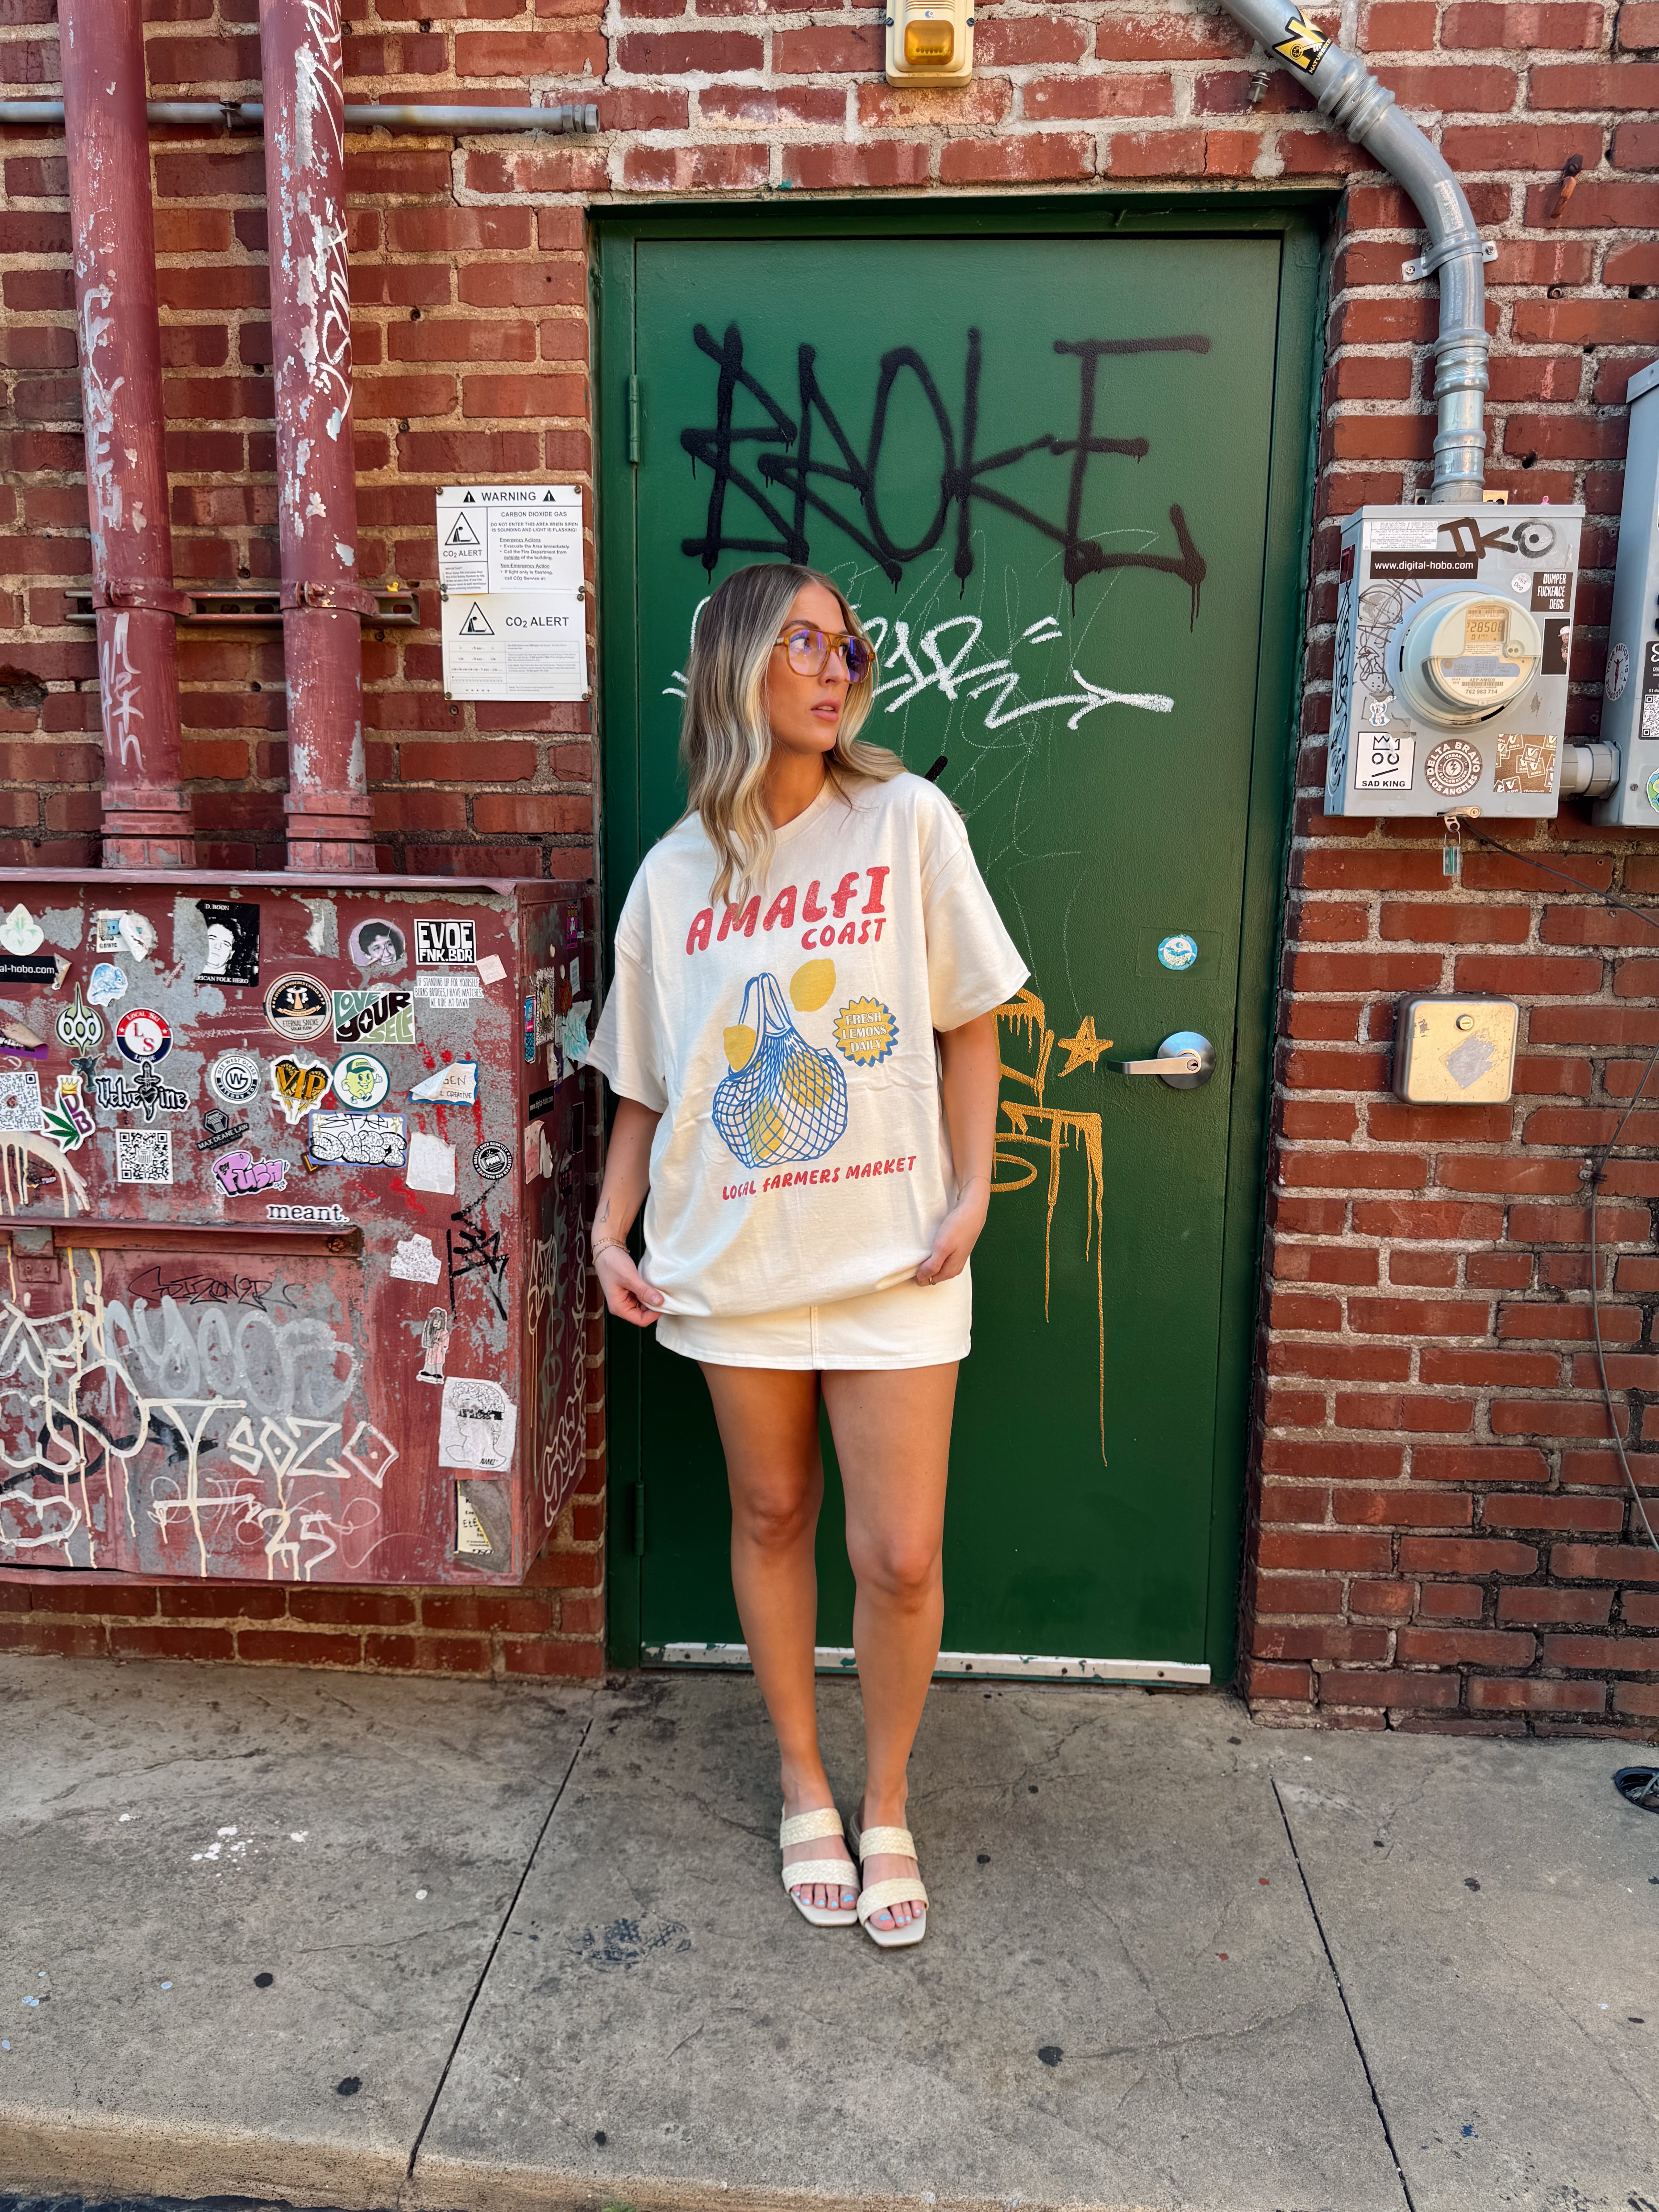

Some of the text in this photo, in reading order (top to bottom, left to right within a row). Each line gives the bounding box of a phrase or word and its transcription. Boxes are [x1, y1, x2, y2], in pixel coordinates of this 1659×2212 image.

[481, 492, 536, 501] WARNING
[1375, 561, 1473, 571] www.digital-hobo.com
[1543, 573, 1566, 584] DUMPER
[1514, 582, 1523, 591] Dog
[1537, 586, 1565, 597] FUCKFACE
[1549, 599, 1565, 610] DEGS
[506, 617, 569, 628] CO2 ALERT
[1616, 644, 1628, 662] PASTOR
[1606, 651, 1615, 673] YOUR
[1606, 679, 1623, 699] PEDOPHILE
[1427, 742, 1480, 775] DELTA BRAVO
[1439, 770, 1468, 783] EXPLORATION
[1429, 775, 1478, 795] LOS ANGELES
[418, 922, 472, 949] EVOE
[801, 918, 886, 950] COAST
[419, 949, 473, 962] FNK.BDR
[418, 978, 421, 987] IF
[423, 978, 443, 987] STANDING
[445, 978, 449, 987] UP
[460, 978, 479, 987] YOURSELF
[415, 988, 428, 997] BURNS
[450, 988, 460, 997] HAVE
[431, 998, 468, 1007] WE RIDE AT DAWN
[334, 992, 381, 1028] LOVE
[337, 993, 411, 1042] YOUR
[357, 1004, 413, 1042] SELF
[845, 1012, 881, 1025] FRESH
[842, 1025, 887, 1039] LEMONS
[850, 1039, 882, 1053] DAILY
[242, 1060, 256, 1076] GLASS
[276, 1066, 326, 1099] VIP
[198, 1139, 213, 1149] MAX
[213, 1130, 235, 1143] DEANE
[234, 1123, 248, 1134] LAW
[722, 1156, 917, 1200] LOCAL FARMERS MARKET
[269, 1206, 349, 1221] meant.
